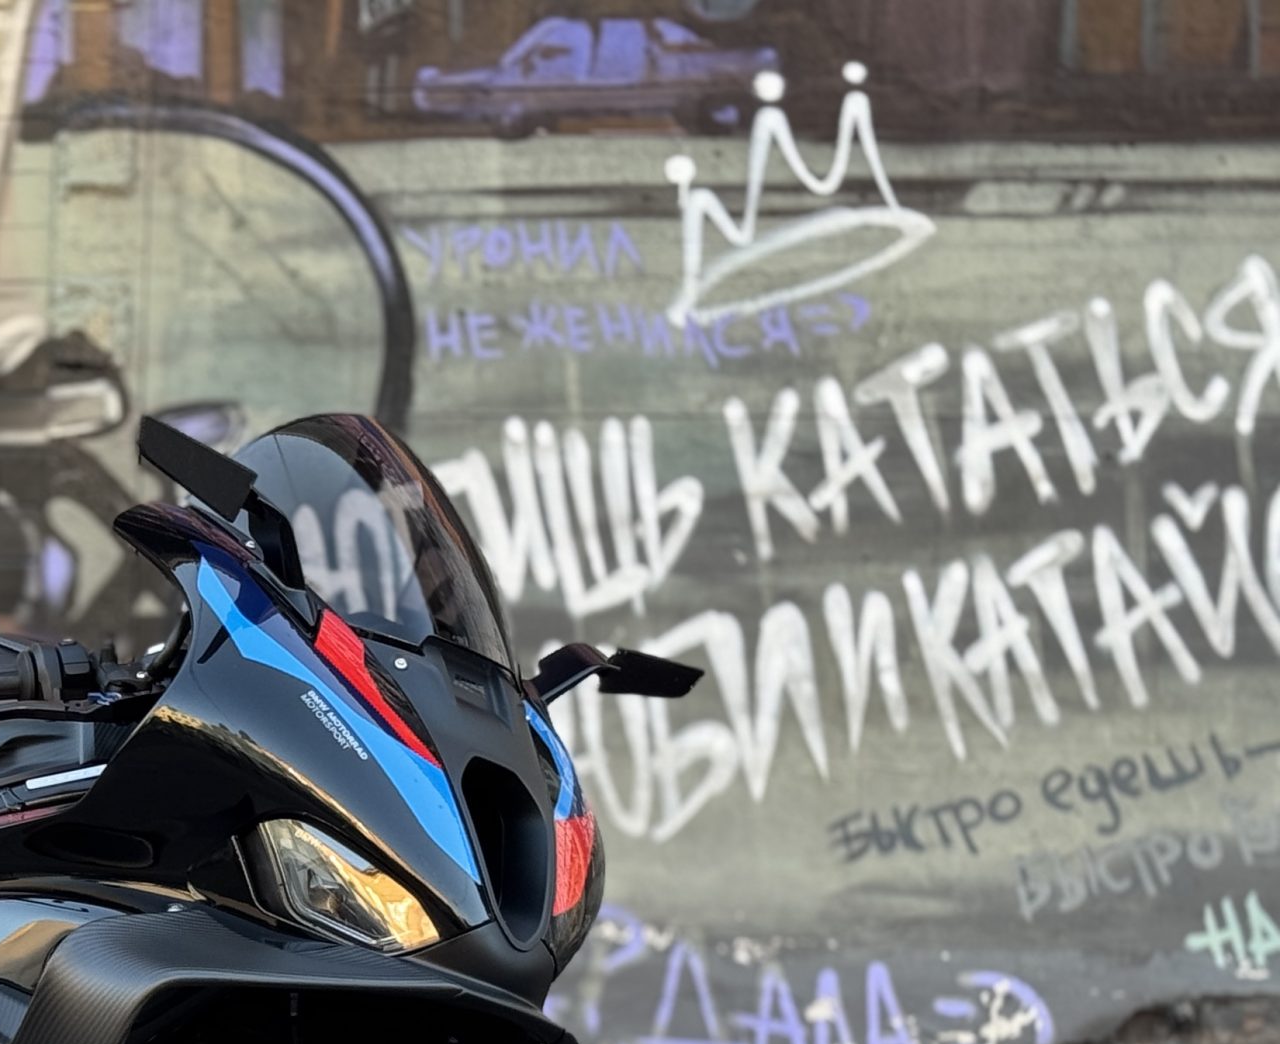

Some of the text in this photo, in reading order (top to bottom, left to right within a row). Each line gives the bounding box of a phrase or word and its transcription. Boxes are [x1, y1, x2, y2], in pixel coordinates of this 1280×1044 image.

[402, 222, 646, 287] УРОНИЛ
[426, 314, 503, 362] НЕ
[723, 253, 1280, 561] КАТАТЬСЯ
[300, 694, 350, 750] MOTORSPORT
[307, 689, 369, 761] BMW MOTORRAD
